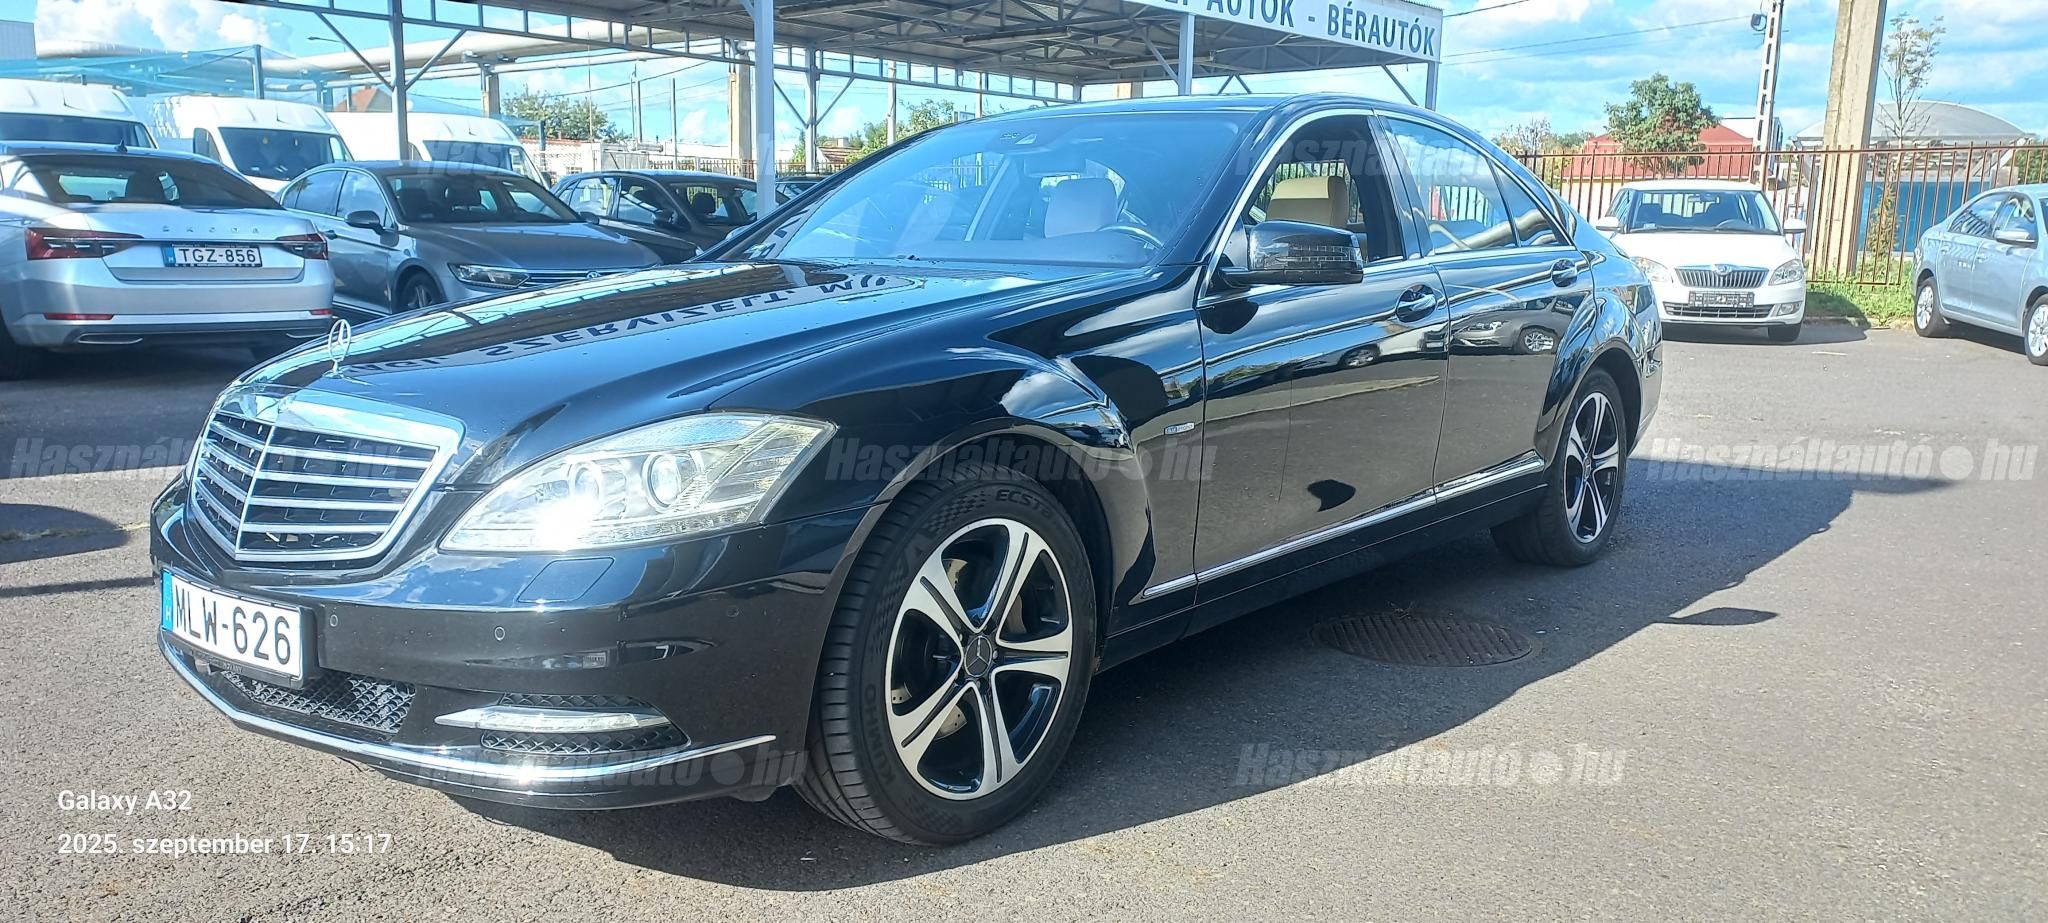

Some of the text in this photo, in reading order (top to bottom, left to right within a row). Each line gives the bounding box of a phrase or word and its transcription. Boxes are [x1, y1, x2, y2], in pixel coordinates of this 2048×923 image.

[1327, 1, 1436, 56] BÉRAUTÓK
[178, 248, 256, 262] TGZ-856
[174, 584, 291, 666] MLW-626
